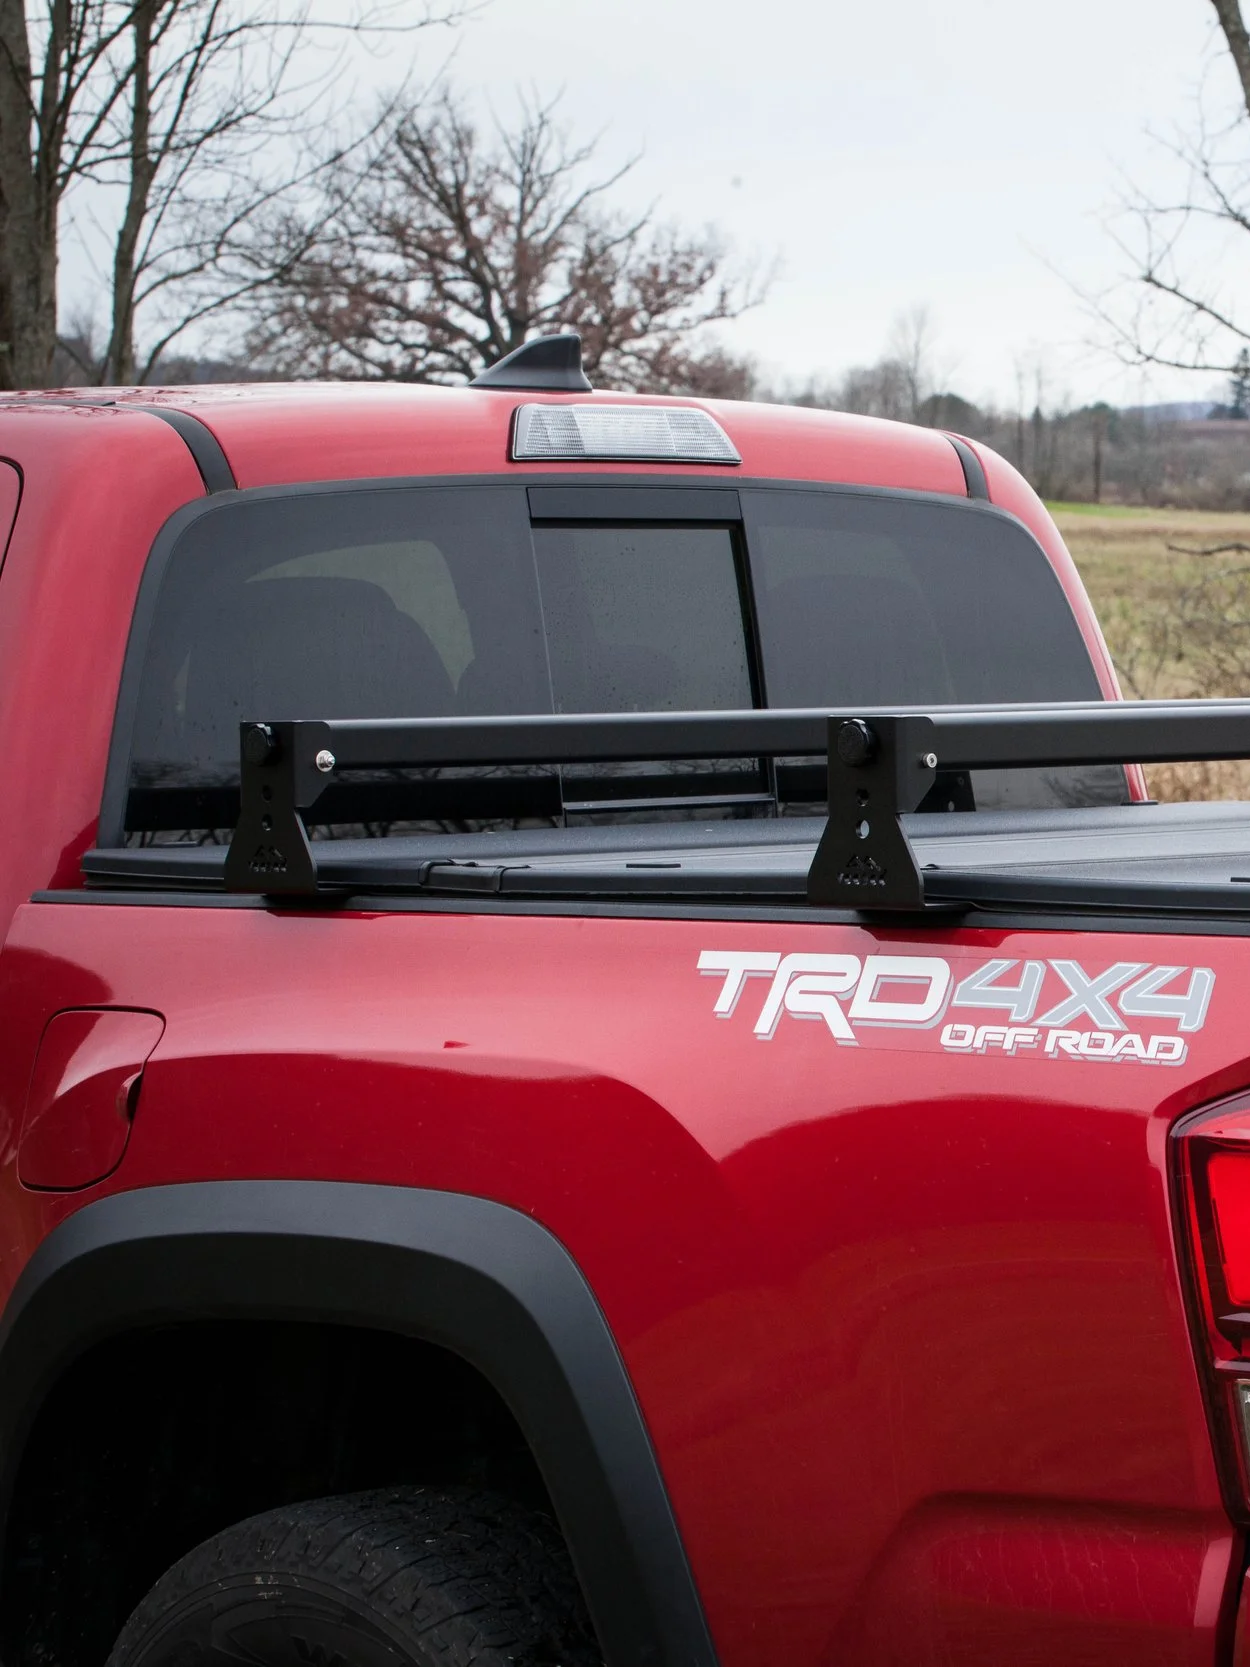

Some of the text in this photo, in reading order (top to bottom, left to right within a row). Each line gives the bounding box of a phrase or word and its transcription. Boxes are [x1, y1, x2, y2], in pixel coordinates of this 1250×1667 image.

[697, 950, 954, 1046] TRD
[940, 1023, 1188, 1067] OFF ROAD
